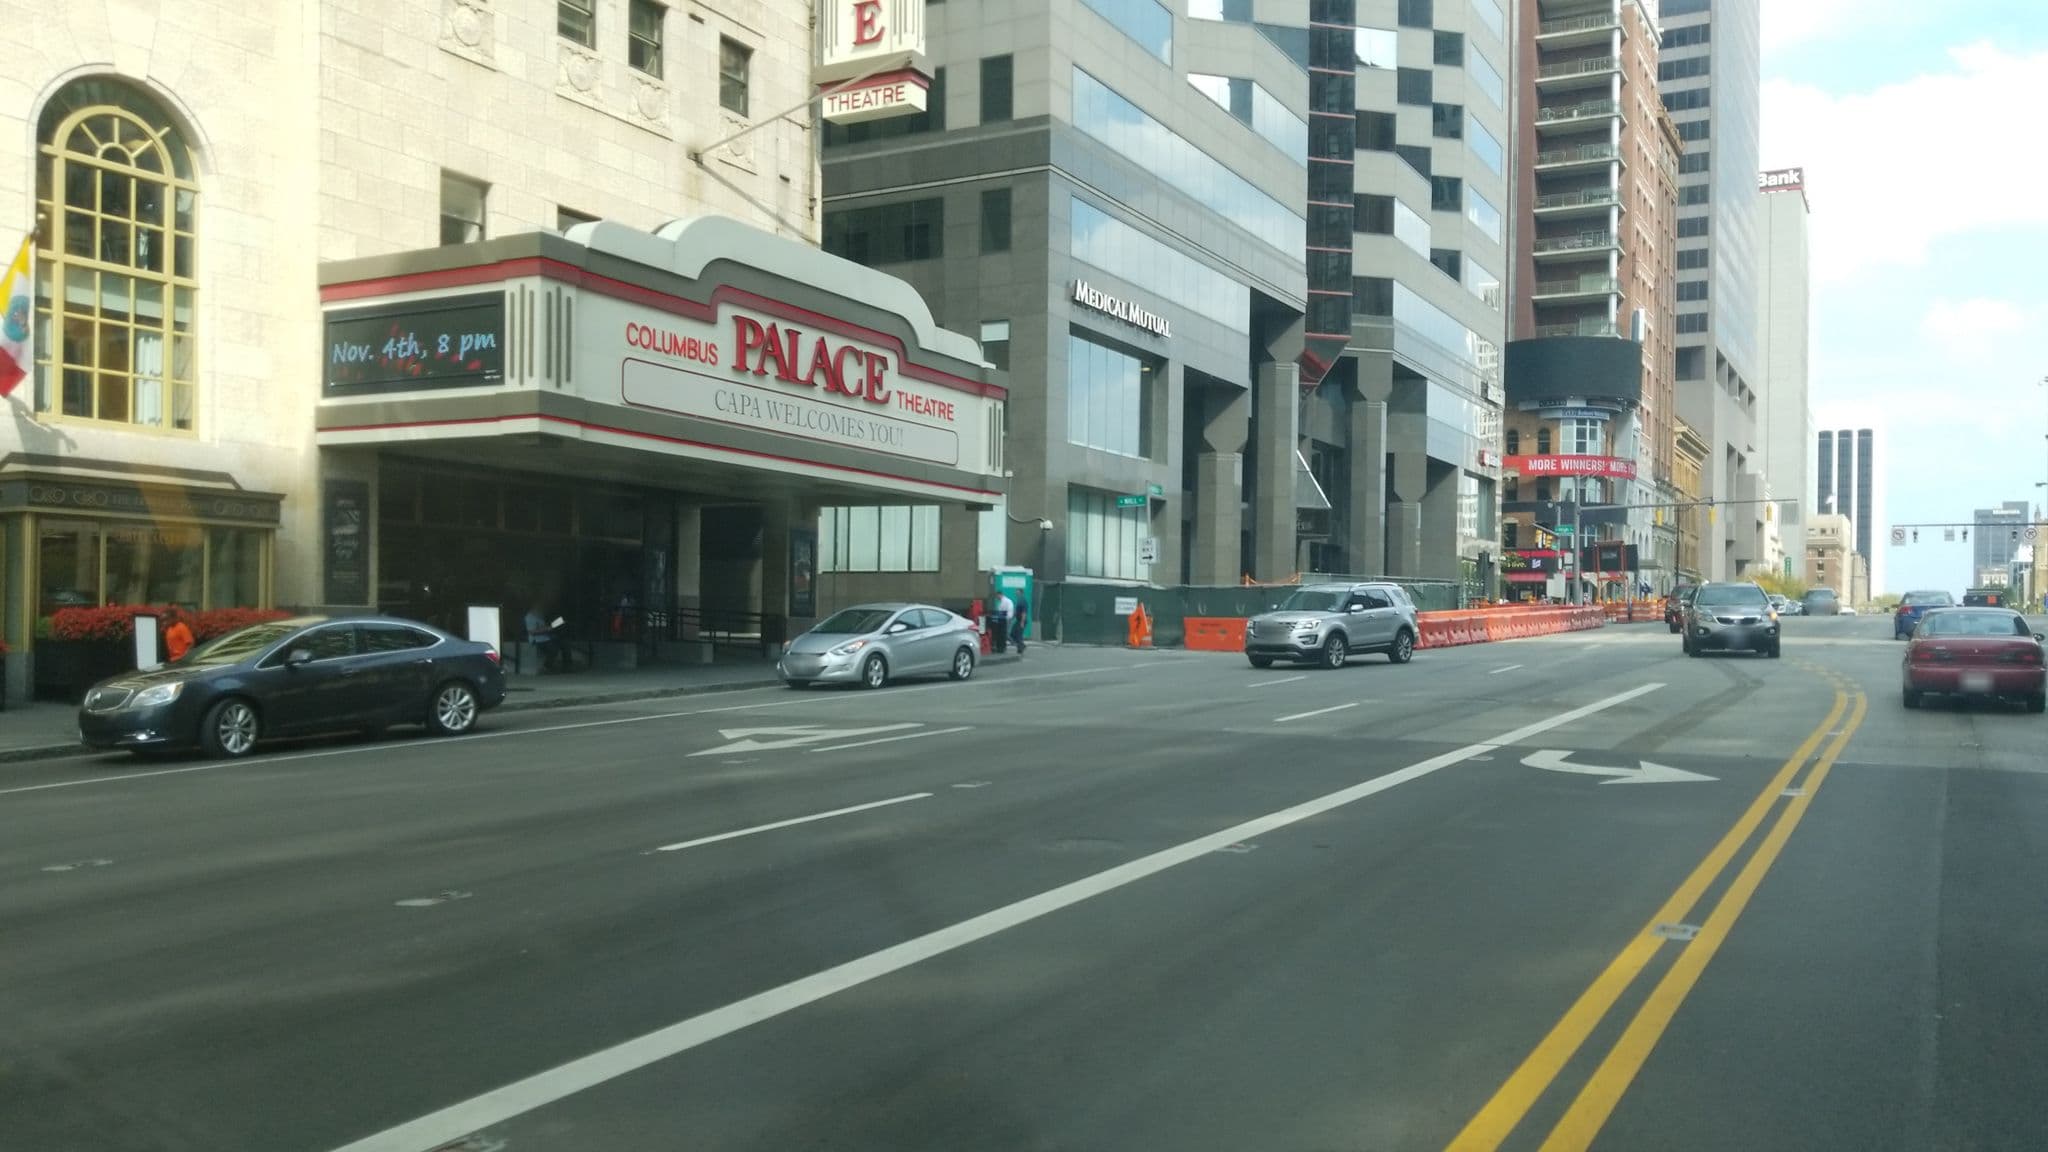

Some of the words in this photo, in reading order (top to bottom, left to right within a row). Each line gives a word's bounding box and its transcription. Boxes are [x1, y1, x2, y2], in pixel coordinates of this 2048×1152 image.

[852, 0, 885, 46] E
[828, 85, 906, 112] THEATRE
[1074, 279, 1128, 320] MEDICAL
[1128, 301, 1172, 338] MUTUAL
[333, 341, 374, 364] Nov.
[382, 332, 427, 359] 4th,
[438, 334, 450, 353] 8
[459, 333, 496, 361] pm
[626, 322, 719, 366] COLUMBUS
[731, 314, 892, 405] PALACE
[897, 390, 955, 421] THEATRE
[714, 388, 762, 419] CAPA
[766, 399, 866, 440] WELCOMES
[868, 422, 904, 448] YOU!
[1528, 459, 1557, 471] MORE
[1560, 459, 1606, 471] WINNERS!
